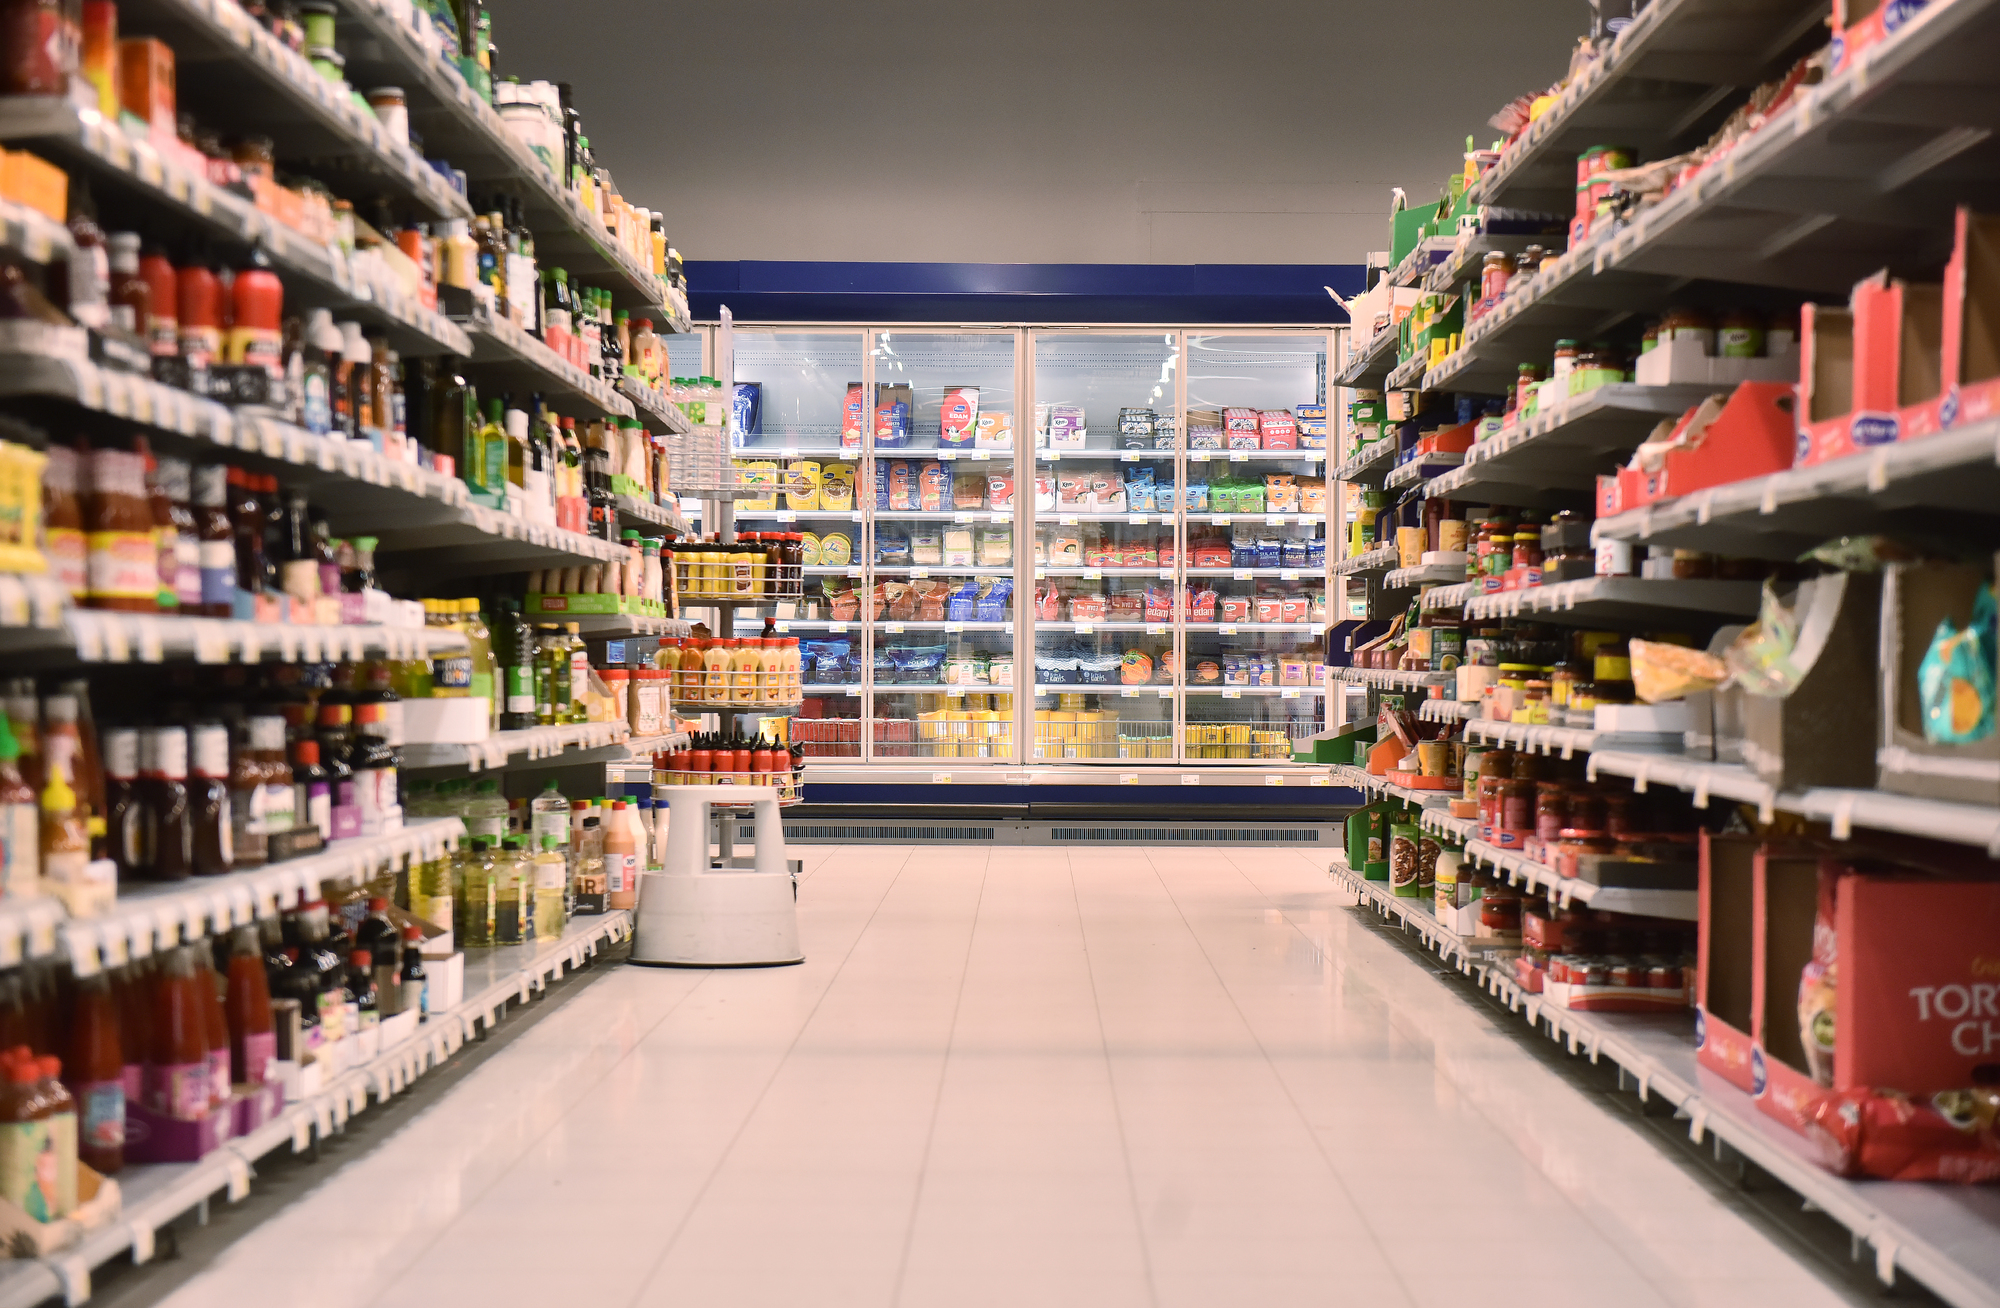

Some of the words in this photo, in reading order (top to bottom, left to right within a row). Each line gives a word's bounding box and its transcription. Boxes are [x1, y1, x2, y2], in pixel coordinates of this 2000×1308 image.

[1146, 607, 1169, 618] edam
[1193, 607, 1215, 616] edam
[1908, 983, 2000, 1021] TOR
